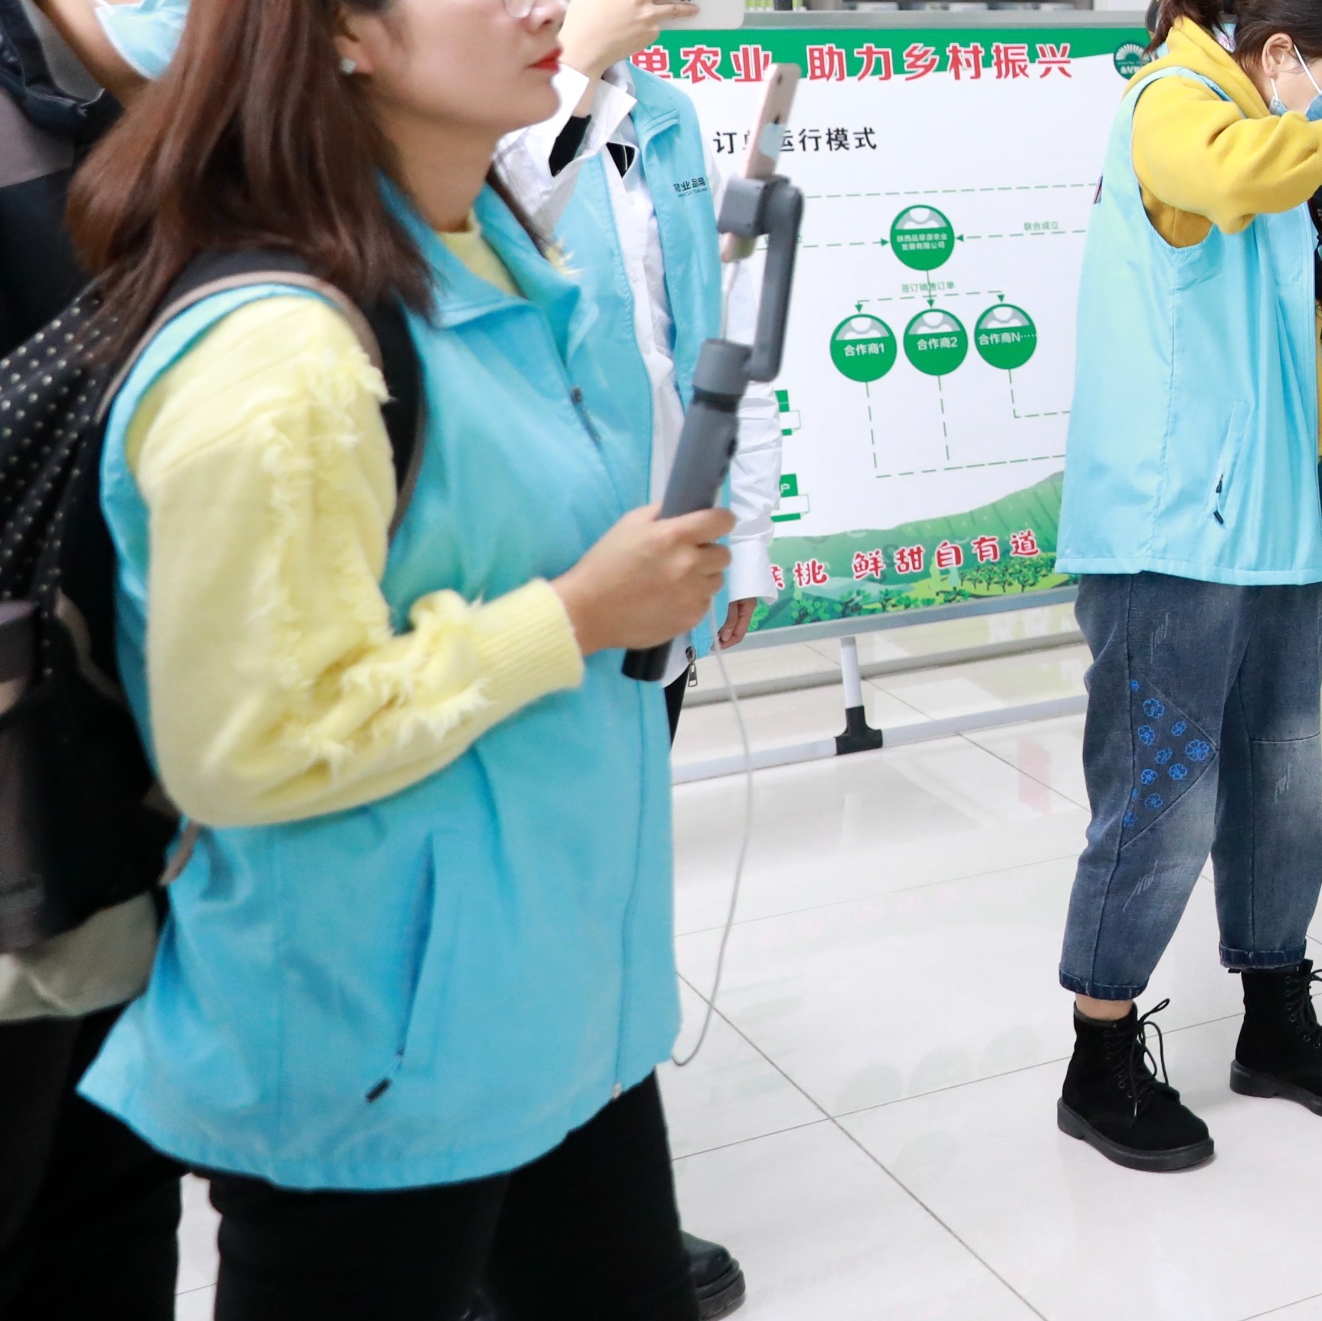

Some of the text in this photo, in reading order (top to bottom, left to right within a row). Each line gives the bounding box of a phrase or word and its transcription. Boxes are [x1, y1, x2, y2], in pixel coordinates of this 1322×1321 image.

[804, 42, 1073, 82] 助力乡村振兴
[843, 343, 885, 358] 合作商1
[916, 336, 958, 352] 合作商2
[851, 529, 1039, 580] 鲜甜自有道
